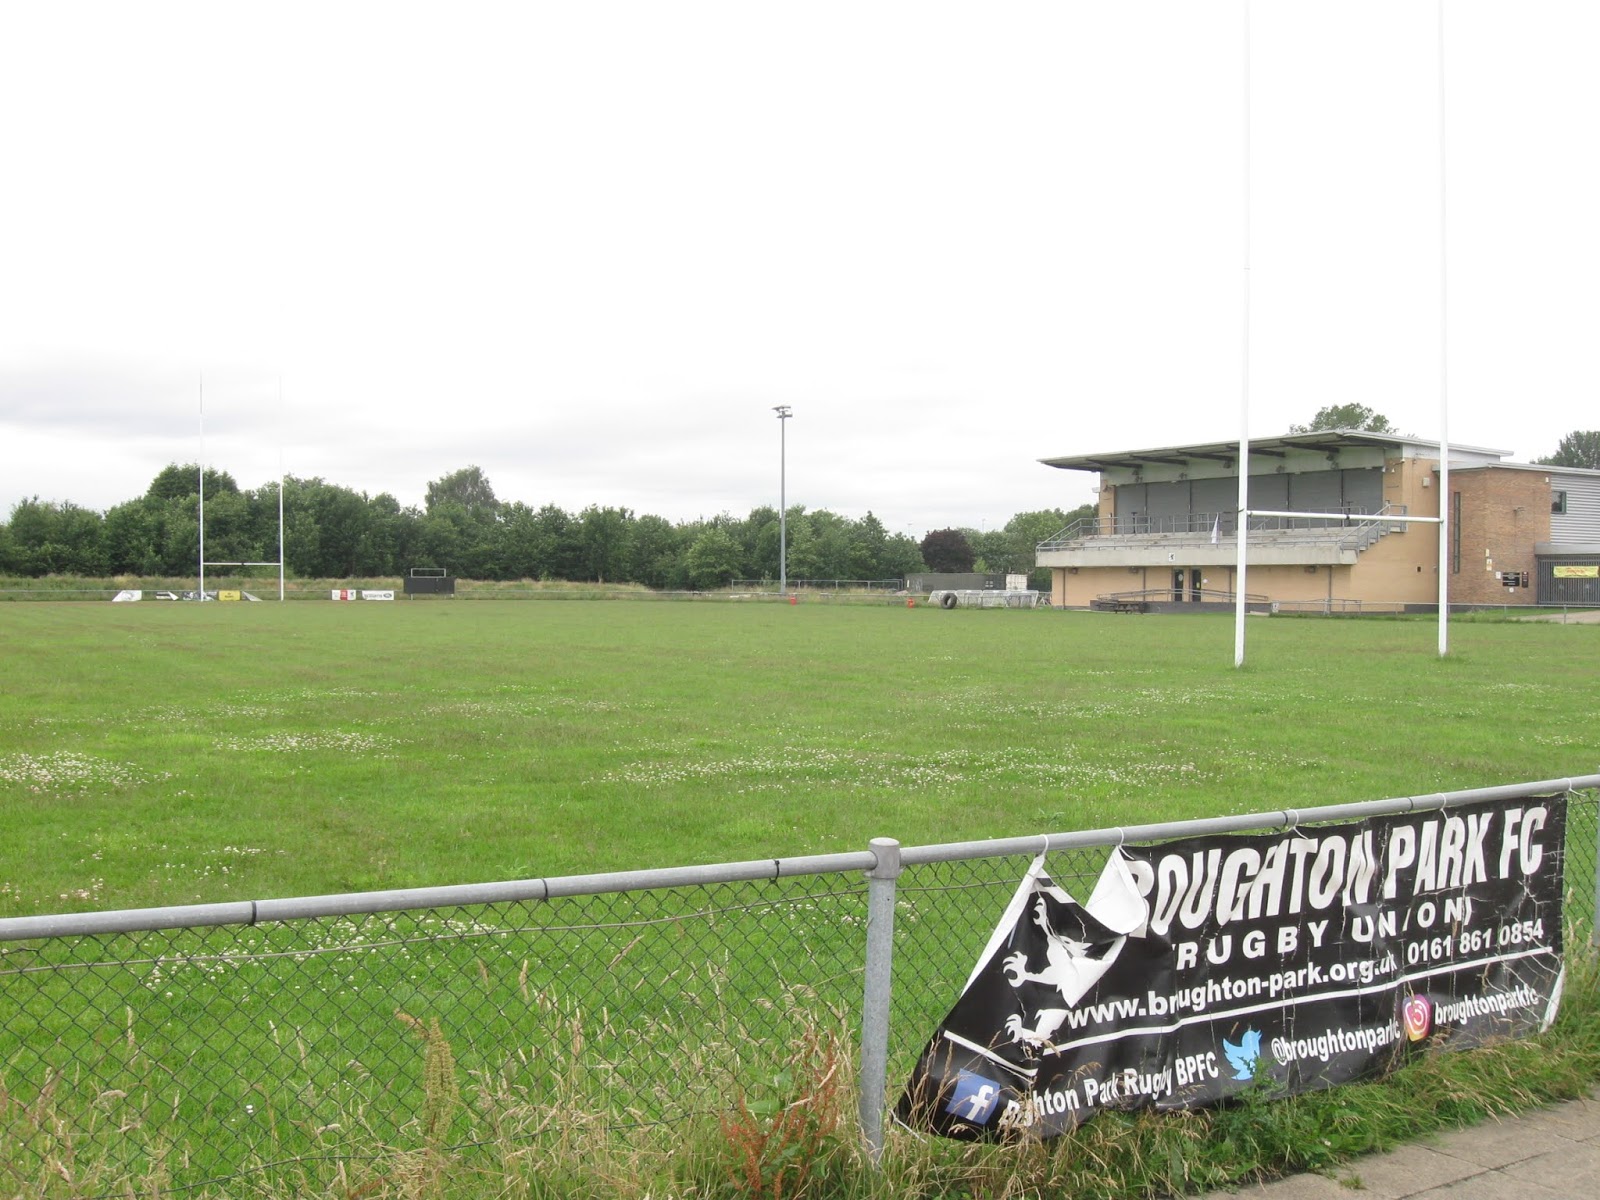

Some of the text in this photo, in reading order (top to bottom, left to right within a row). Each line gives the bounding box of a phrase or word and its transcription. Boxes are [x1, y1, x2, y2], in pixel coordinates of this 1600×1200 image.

[1384, 813, 1493, 900] PARK
[1500, 806, 1547, 879] FC
[1068, 918, 1543, 1029] www.brughton-park.org.uk 0161 861 0854
[1172, 919, 1329, 971] RUGBY
[1083, 1072, 1121, 1106] Park
[1175, 1051, 1219, 1086] BPFC
